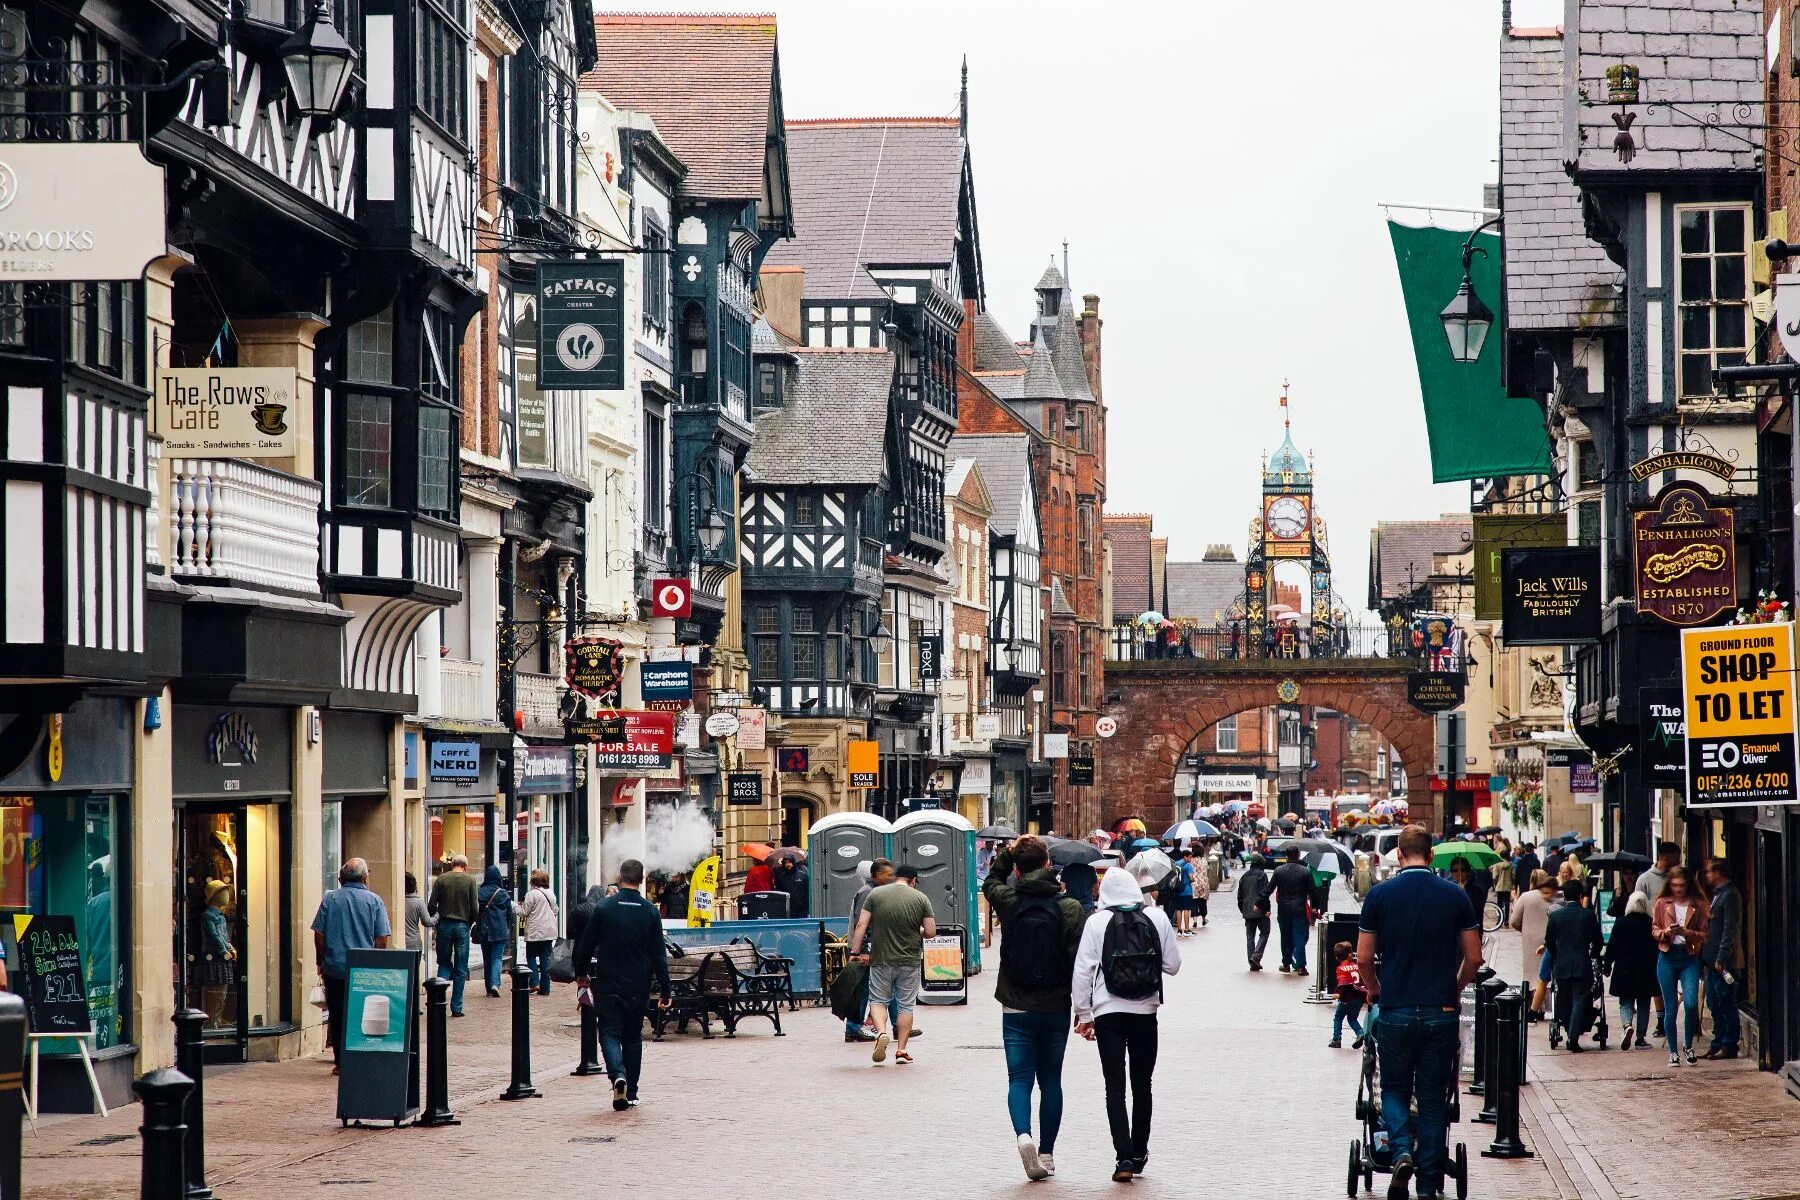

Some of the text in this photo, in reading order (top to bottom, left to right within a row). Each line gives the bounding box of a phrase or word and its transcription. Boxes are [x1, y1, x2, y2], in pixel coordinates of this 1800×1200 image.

[544, 278, 617, 298] FATFACE
[162, 376, 265, 405] The Rows
[170, 400, 219, 429] Café
[204, 440, 250, 448] Sandwiches
[1636, 454, 1732, 478] PENHALIGON'S
[1638, 528, 1731, 541] PENHALIGON'S
[1654, 550, 1718, 574] PERFUMERS
[1516, 577, 1588, 596] Jack Wills
[1643, 587, 1730, 598] ESTABLISHED
[1523, 599, 1580, 607] FABULOUSLY
[1532, 608, 1571, 616] BRITISH
[1671, 604, 1704, 615] 1870
[1700, 637, 1774, 652] GROUND FLOOR
[577, 646, 610, 656] GODSTALL
[922, 641, 932, 675] next
[1700, 652, 1776, 684] SHOP
[648, 671, 688, 680] Carphone
[1650, 705, 1681, 717] The
[1695, 690, 1784, 722] TO LET
[599, 743, 658, 752] FOR SALE
[1742, 742, 1780, 754] Emanuel
[599, 754, 659, 764] 0161 235 8998
[1553, 753, 1568, 761] Centre
[1743, 754, 1768, 765] Oliver
[433, 760, 476, 770] NERO
[1728, 774, 1751, 790] 236
[1756, 772, 1788, 788] 6700
[1698, 790, 1788, 798] ww.emanueloliver.com
[928, 949, 961, 966] SALE
